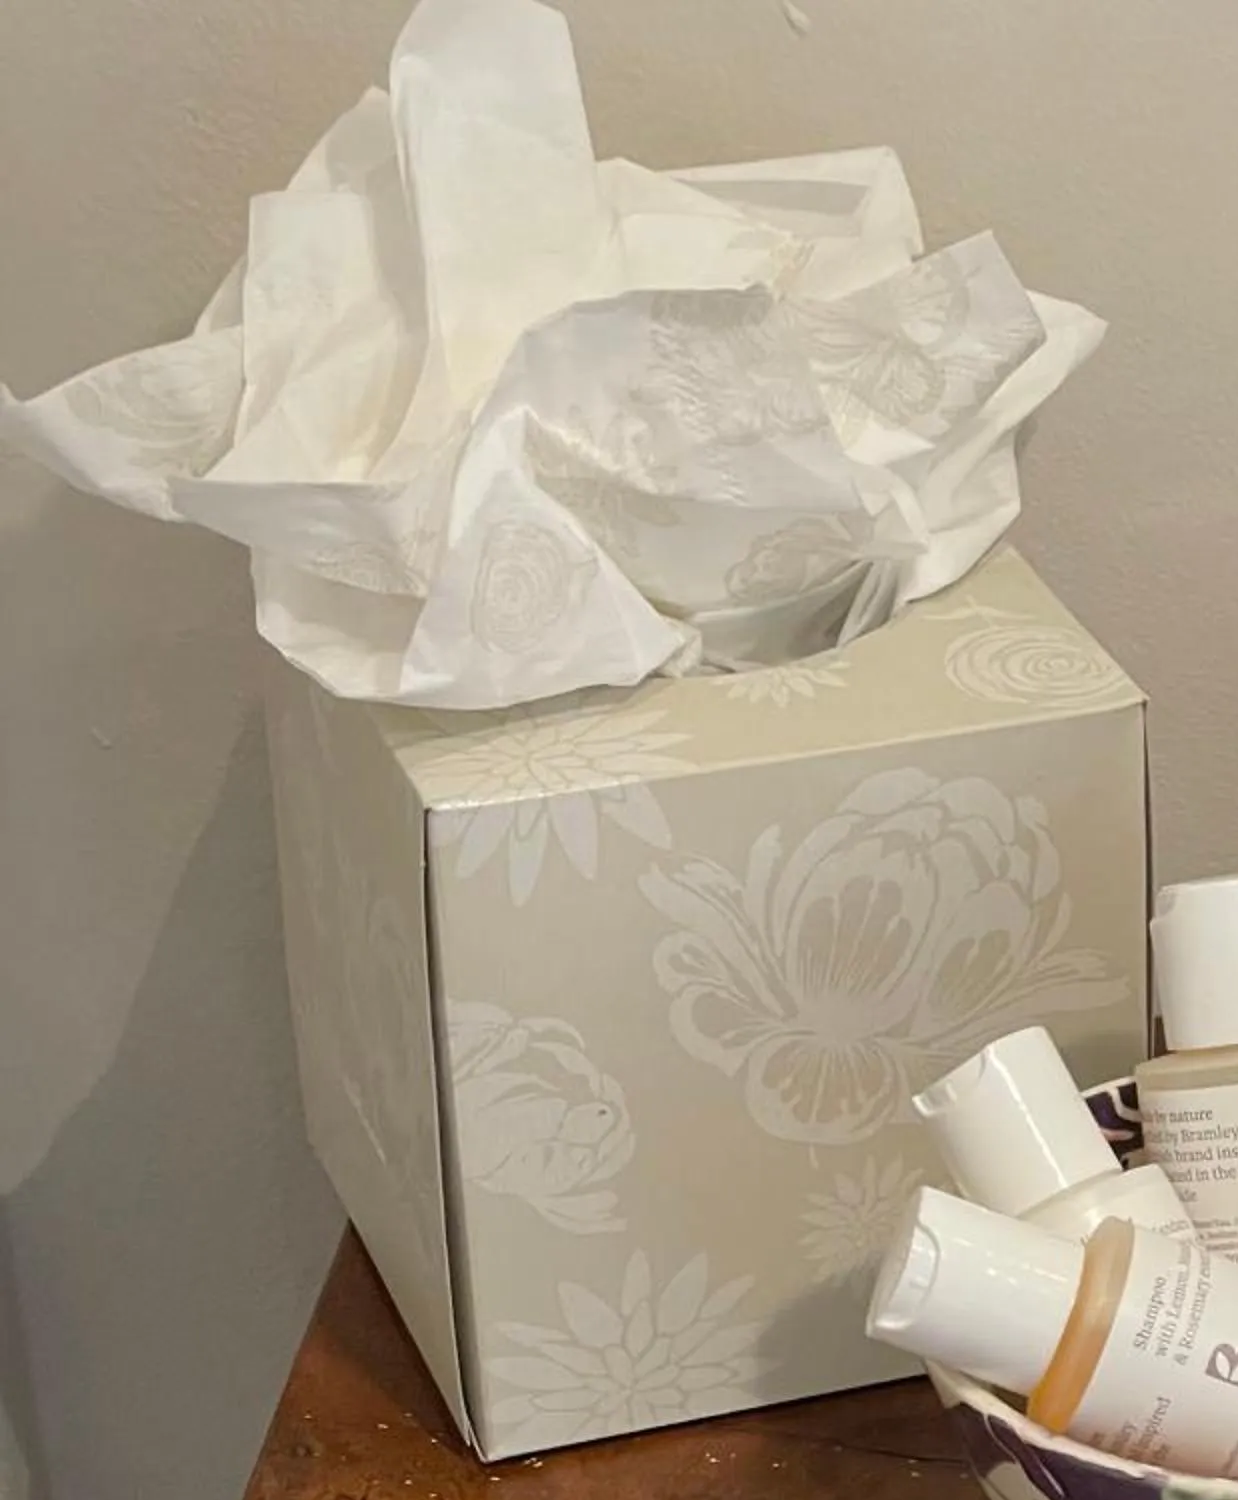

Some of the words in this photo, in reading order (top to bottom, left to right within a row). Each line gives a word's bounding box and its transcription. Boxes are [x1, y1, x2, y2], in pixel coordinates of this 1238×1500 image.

[1169, 1109, 1214, 1123] nature
[1175, 1147, 1214, 1163] brand
[1196, 1168, 1210, 1182] in
[1212, 1165, 1237, 1181] the
[1133, 1276, 1168, 1350] Shampoo
[1178, 1279, 1213, 1351] Rosemary
[1155, 1321, 1177, 1357] with
[1173, 1352, 1190, 1367] &
